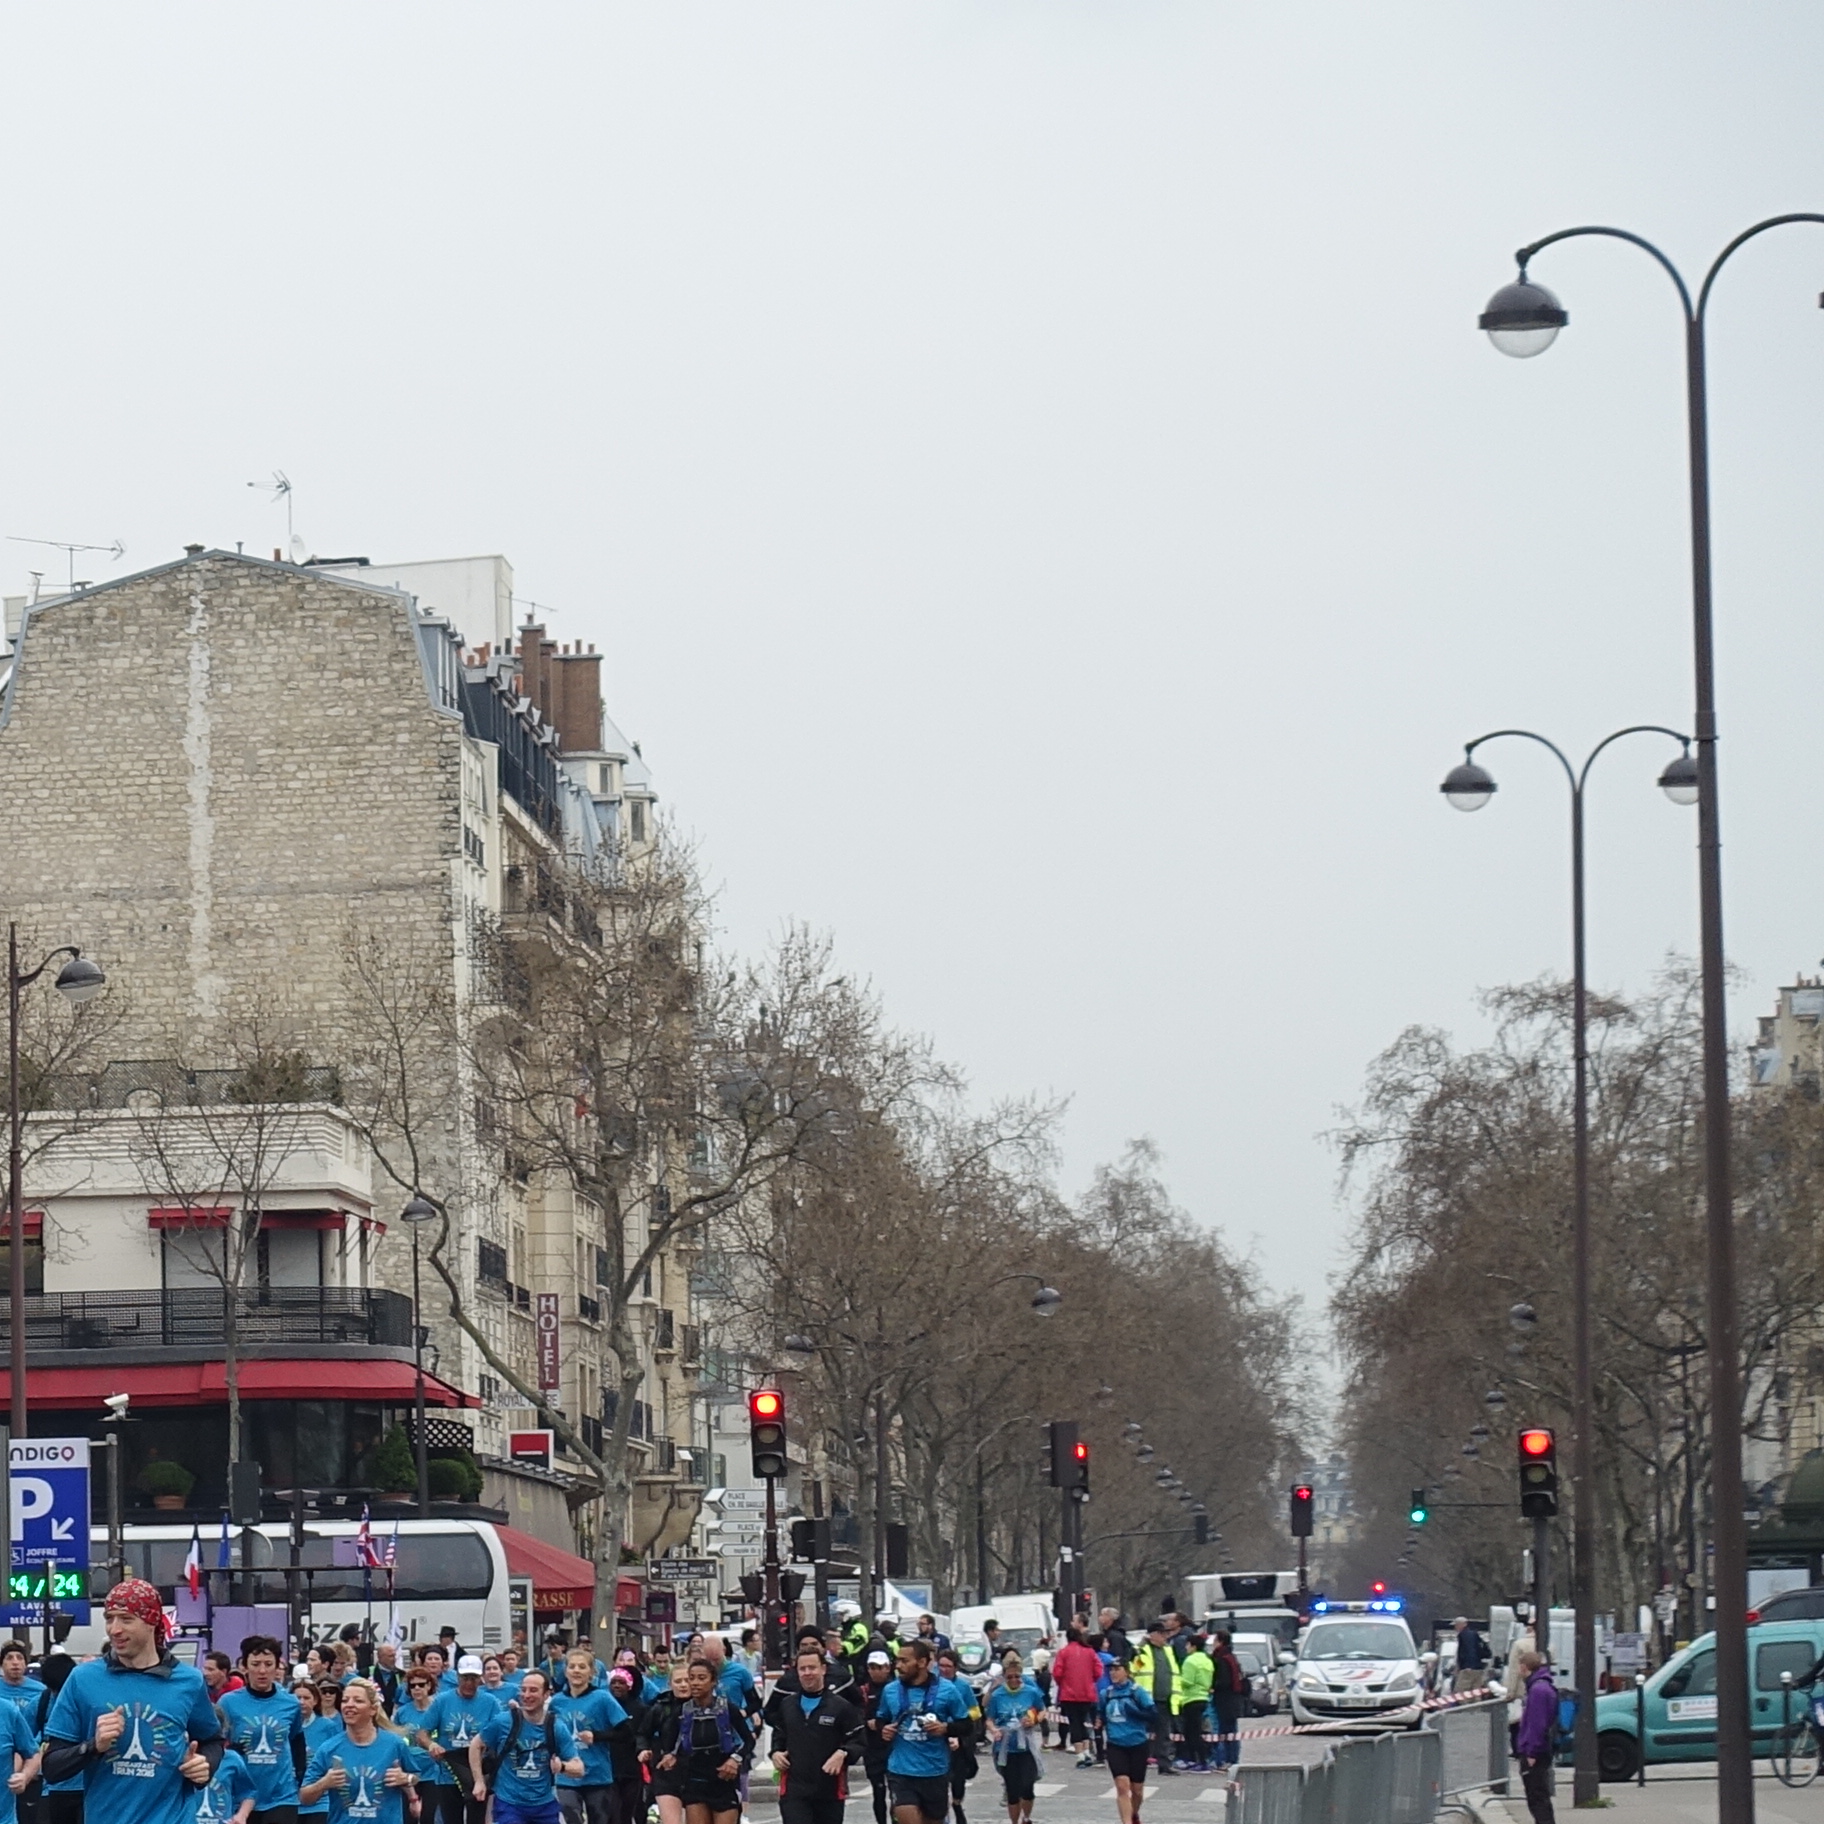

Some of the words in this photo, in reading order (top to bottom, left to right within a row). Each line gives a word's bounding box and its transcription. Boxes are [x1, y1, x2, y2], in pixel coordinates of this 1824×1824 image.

[539, 1296, 557, 1383] HOTEL
[9, 1446, 75, 1462] NDIGO
[8, 1477, 54, 1541] P
[26, 1548, 58, 1556] JOFFRE
[116, 1767, 135, 1777] RUN
